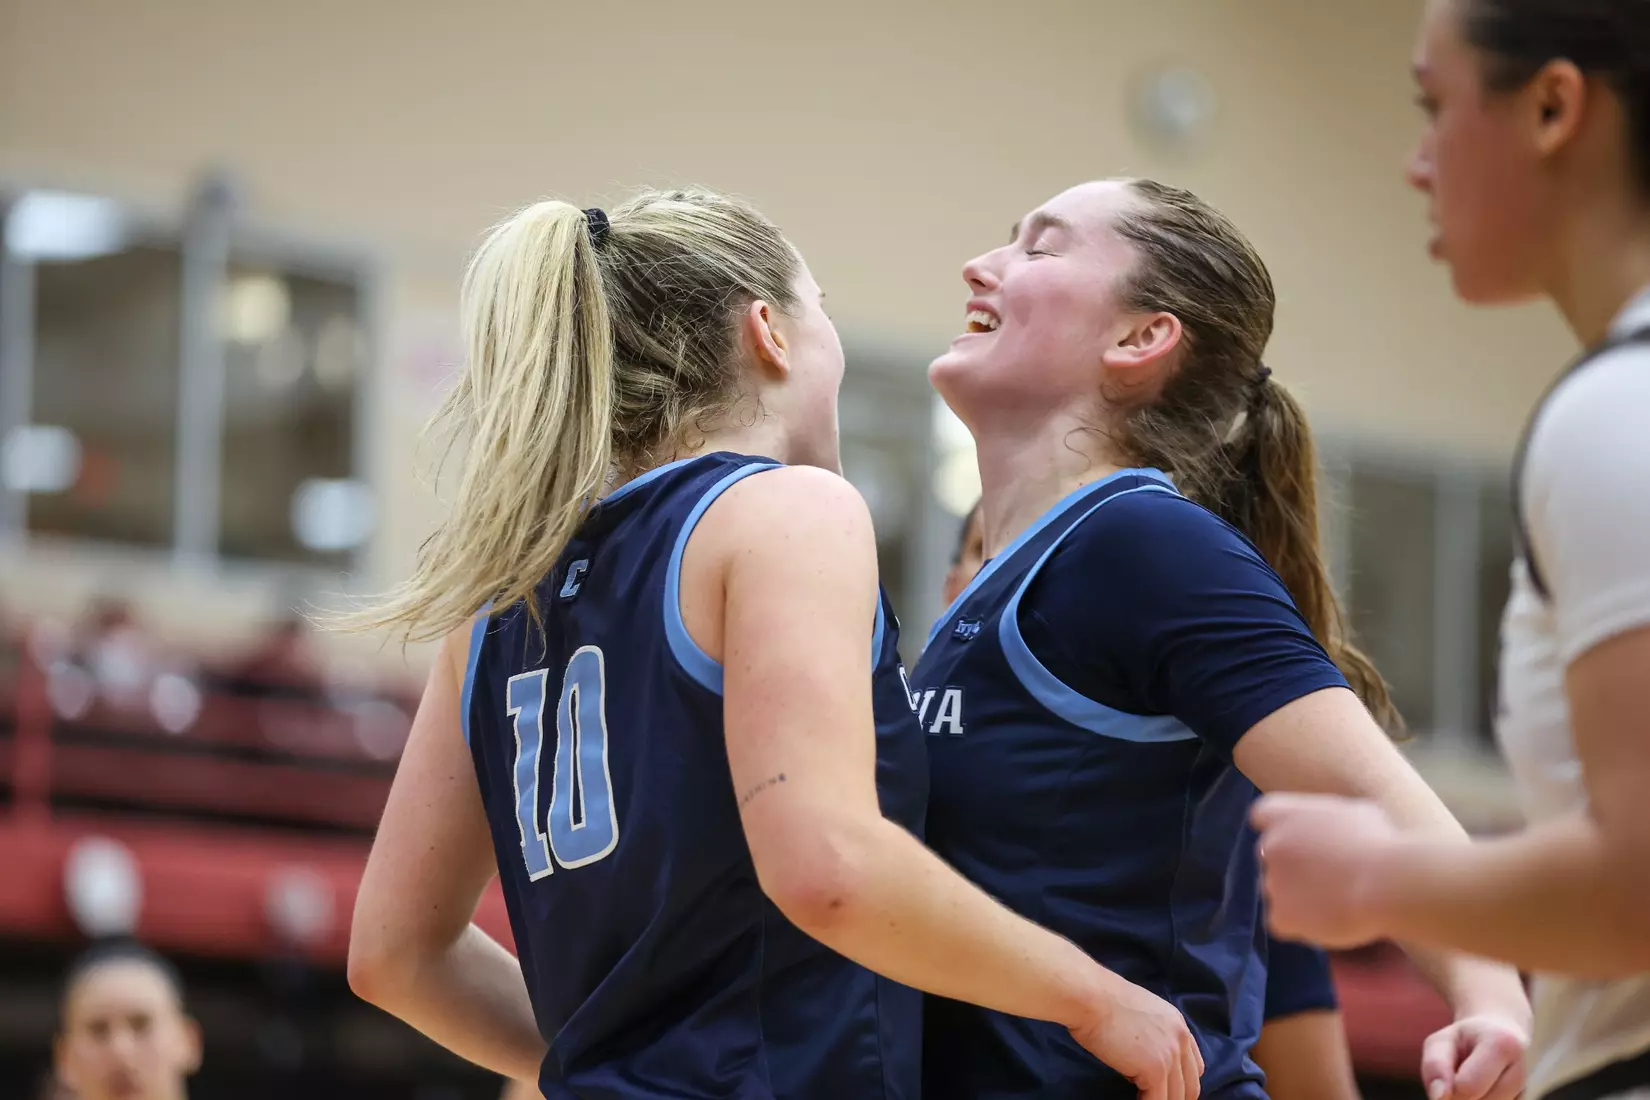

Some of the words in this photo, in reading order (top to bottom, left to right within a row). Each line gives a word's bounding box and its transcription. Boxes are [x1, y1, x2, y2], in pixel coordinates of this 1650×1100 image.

[560, 559, 589, 598] C
[913, 689, 964, 734] IA
[506, 645, 619, 882] 10
